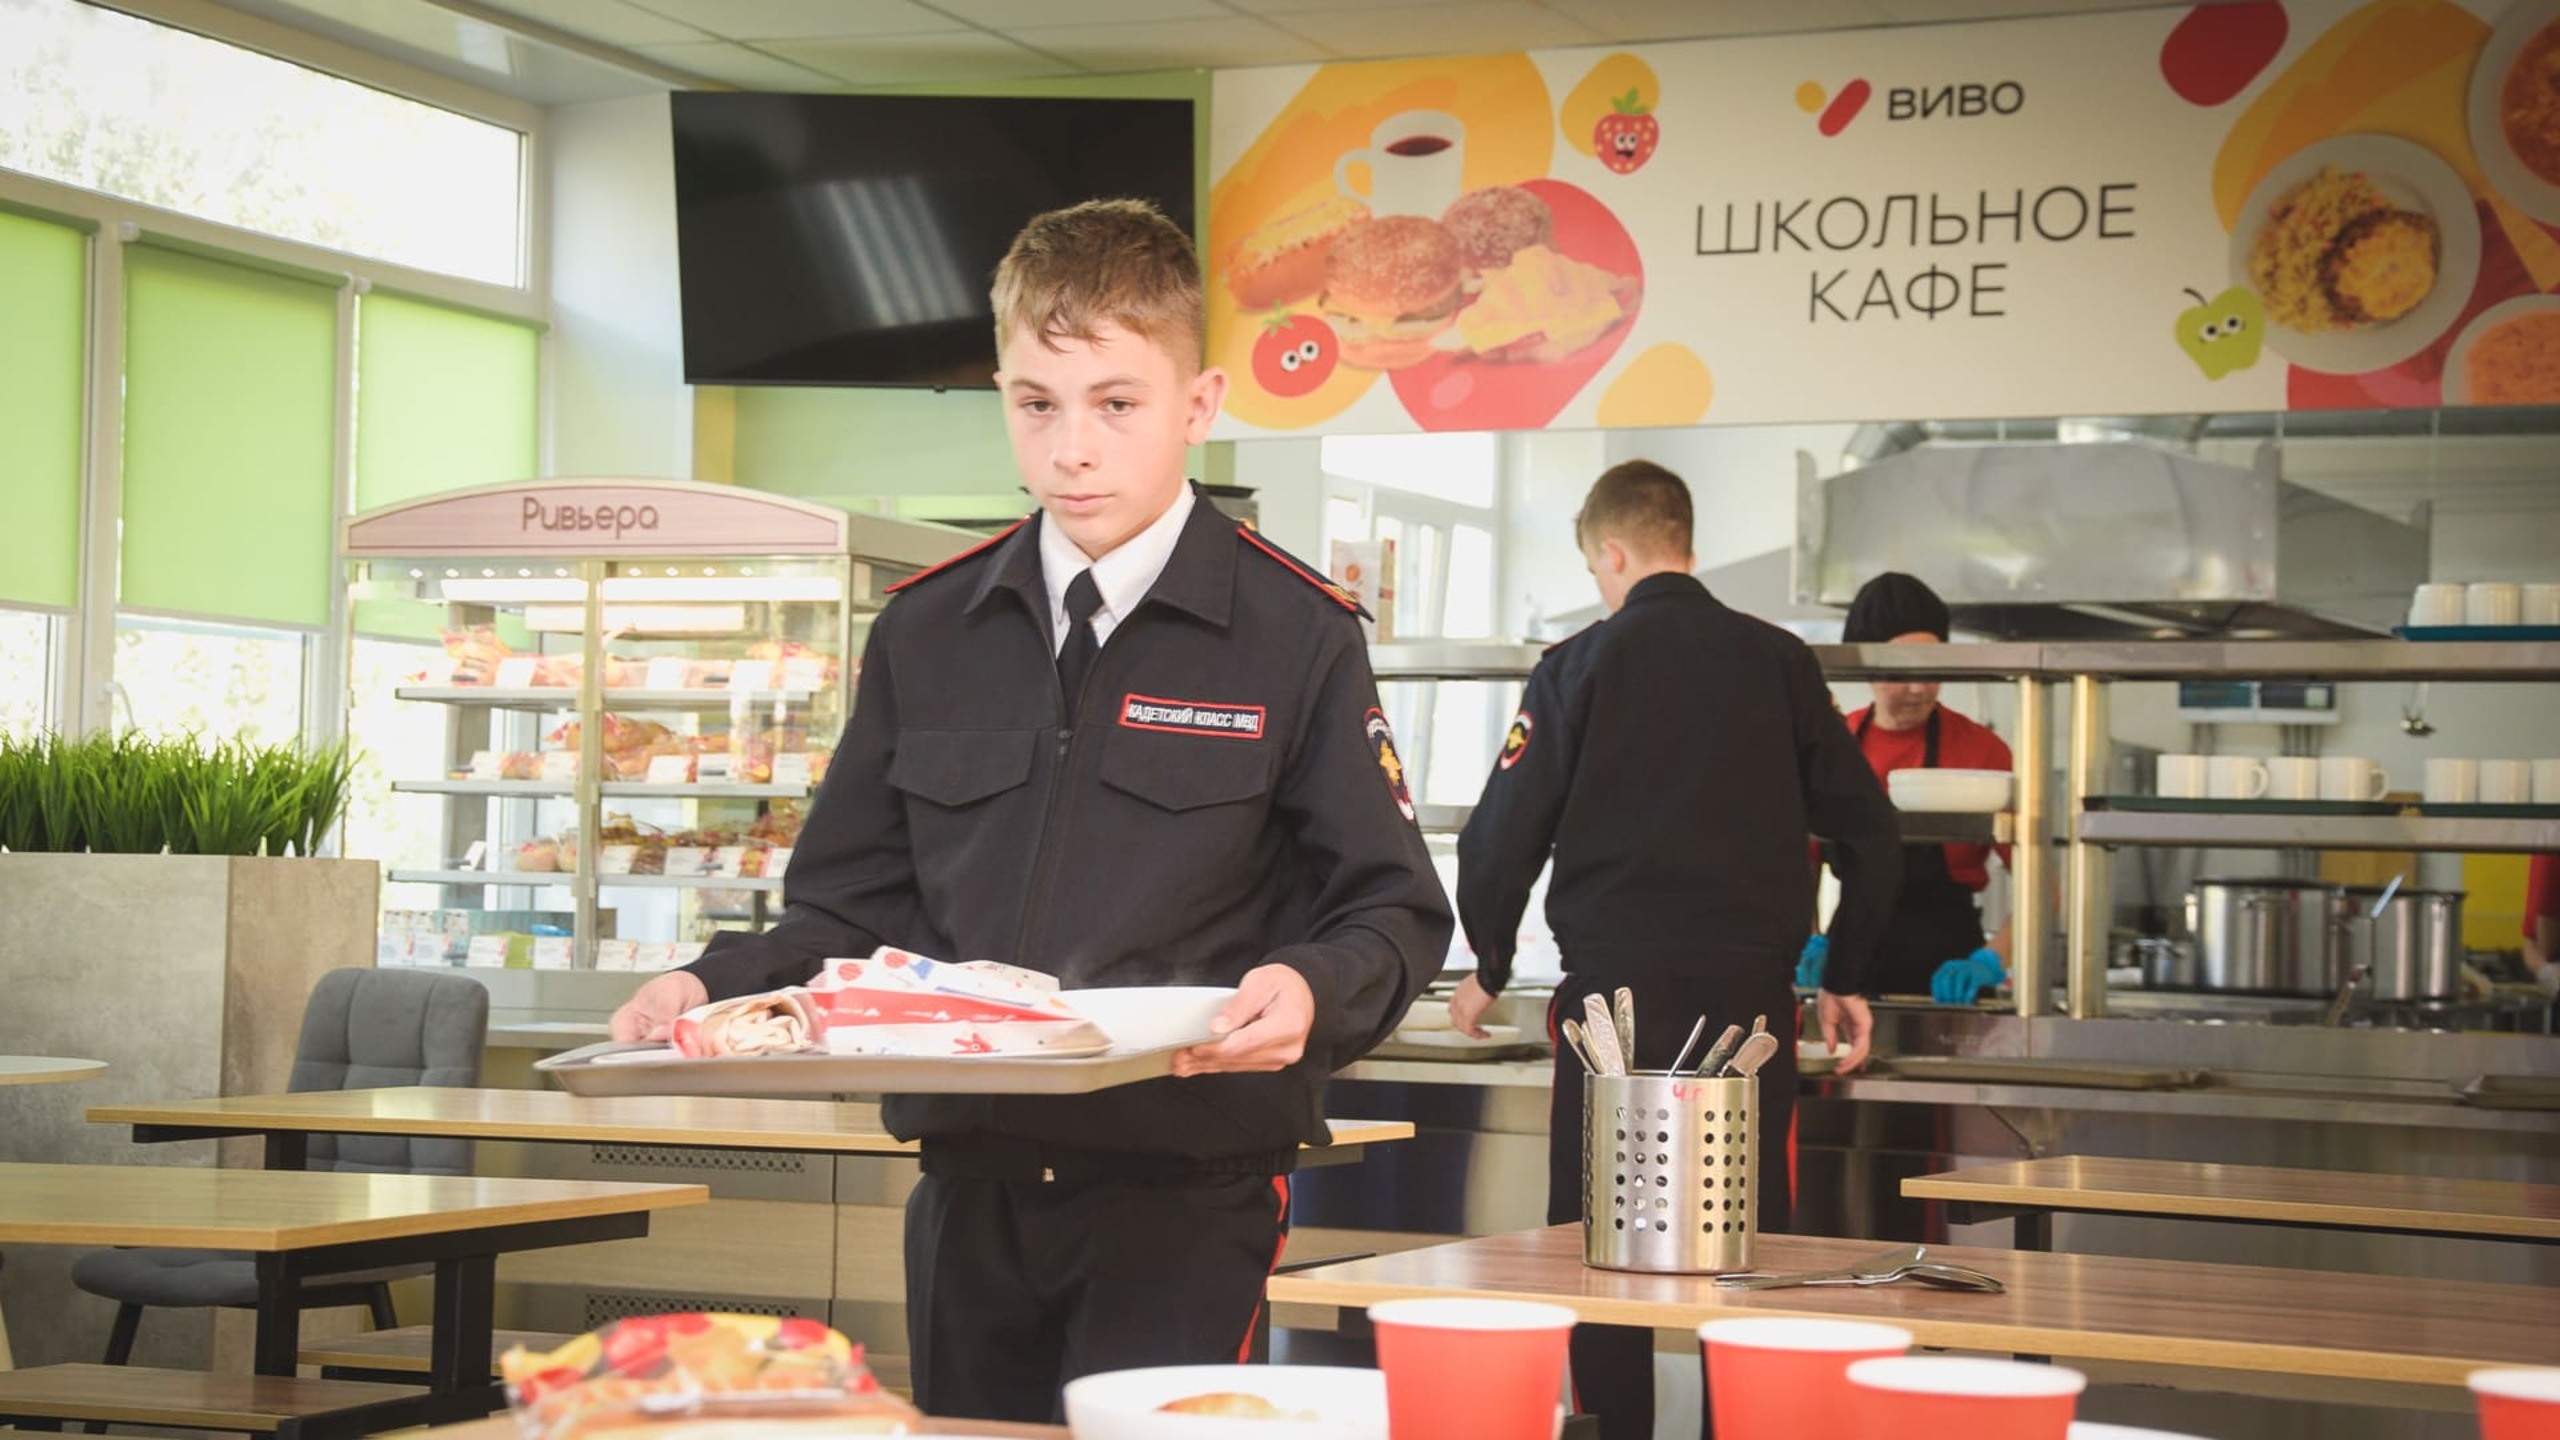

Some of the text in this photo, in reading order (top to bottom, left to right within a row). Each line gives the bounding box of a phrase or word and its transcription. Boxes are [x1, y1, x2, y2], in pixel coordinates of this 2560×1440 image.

[1889, 81, 2025, 120] ВИВО
[1696, 183, 2138, 255] ШКОЛЬНОЕ
[1809, 264, 2008, 323] КАФЕ
[522, 496, 660, 540] Ривьера
[1127, 703, 1259, 732] КАДЕТСКИЙ КЛАСС МВД
